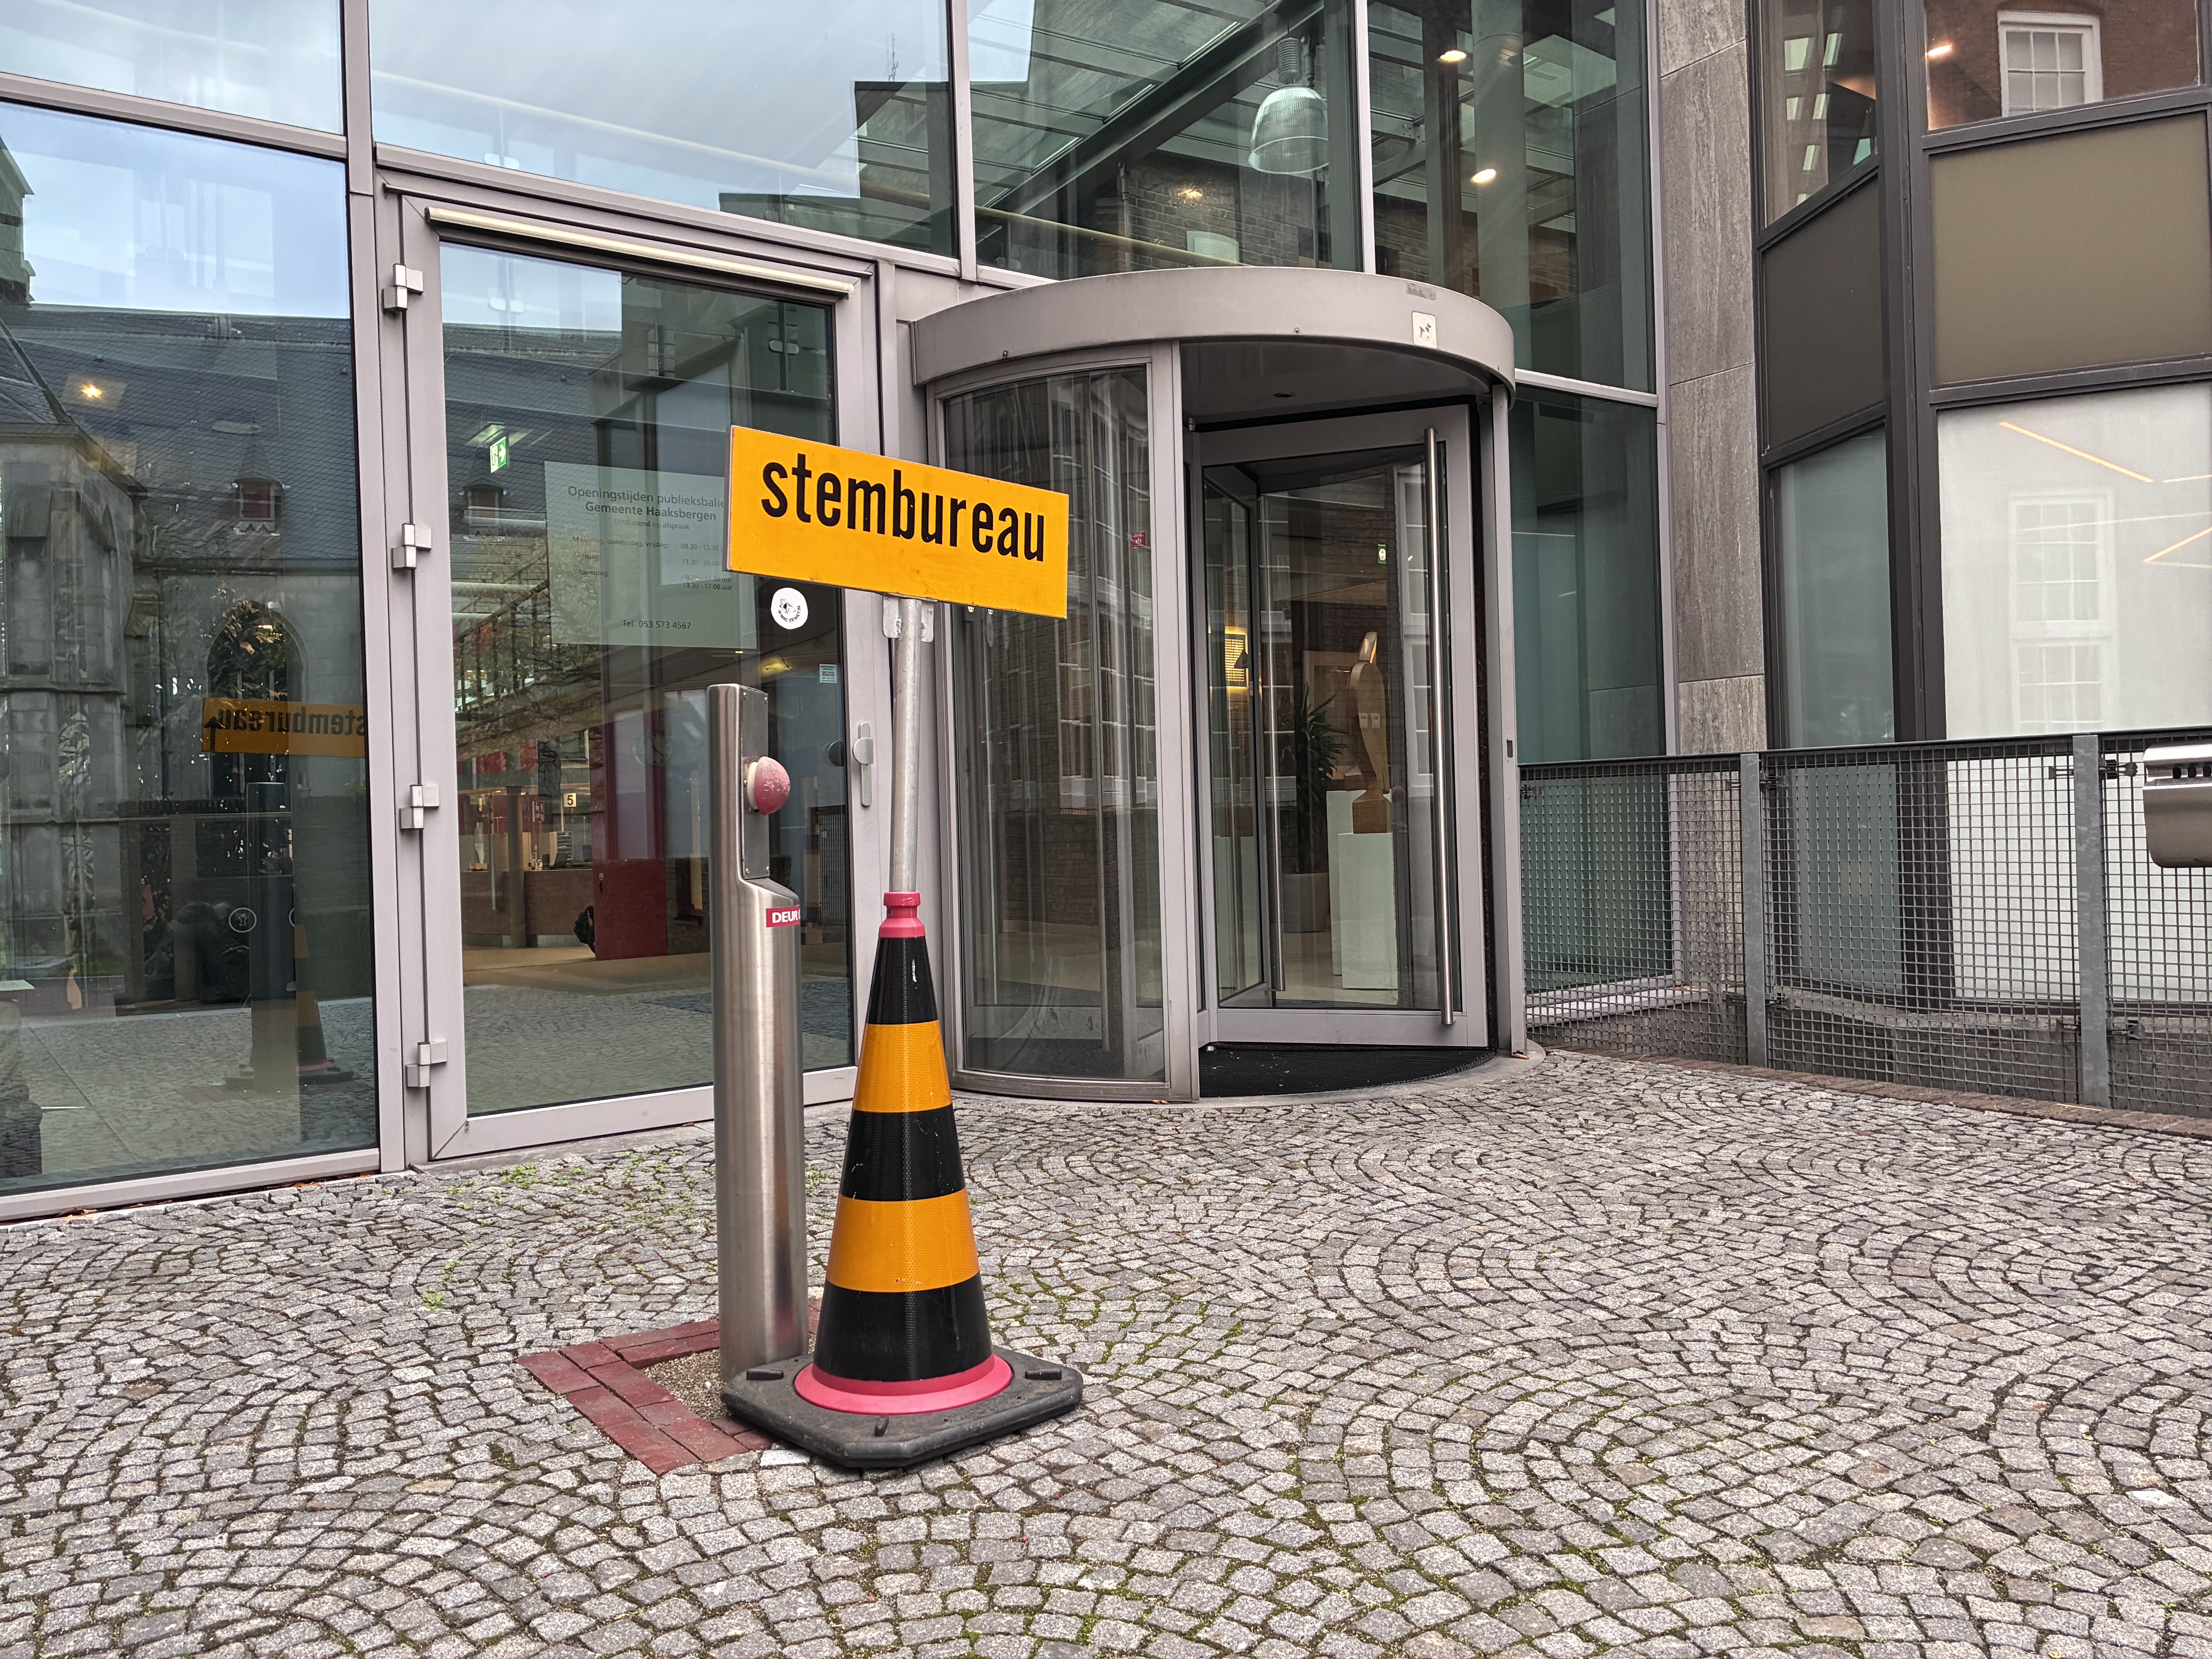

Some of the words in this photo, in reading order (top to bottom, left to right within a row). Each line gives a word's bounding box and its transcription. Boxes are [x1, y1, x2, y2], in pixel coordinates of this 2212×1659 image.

[568, 486, 653, 503] Openingstijden
[586, 501, 643, 515] Gemeente
[646, 507, 716, 522] Haaksbergen
[761, 453, 1044, 562] stembureau
[614, 518, 651, 527] Uitsluitend
[607, 539, 644, 548] donderdag,
[646, 541, 669, 549] vrijdag:
[567, 795, 574, 805] 5
